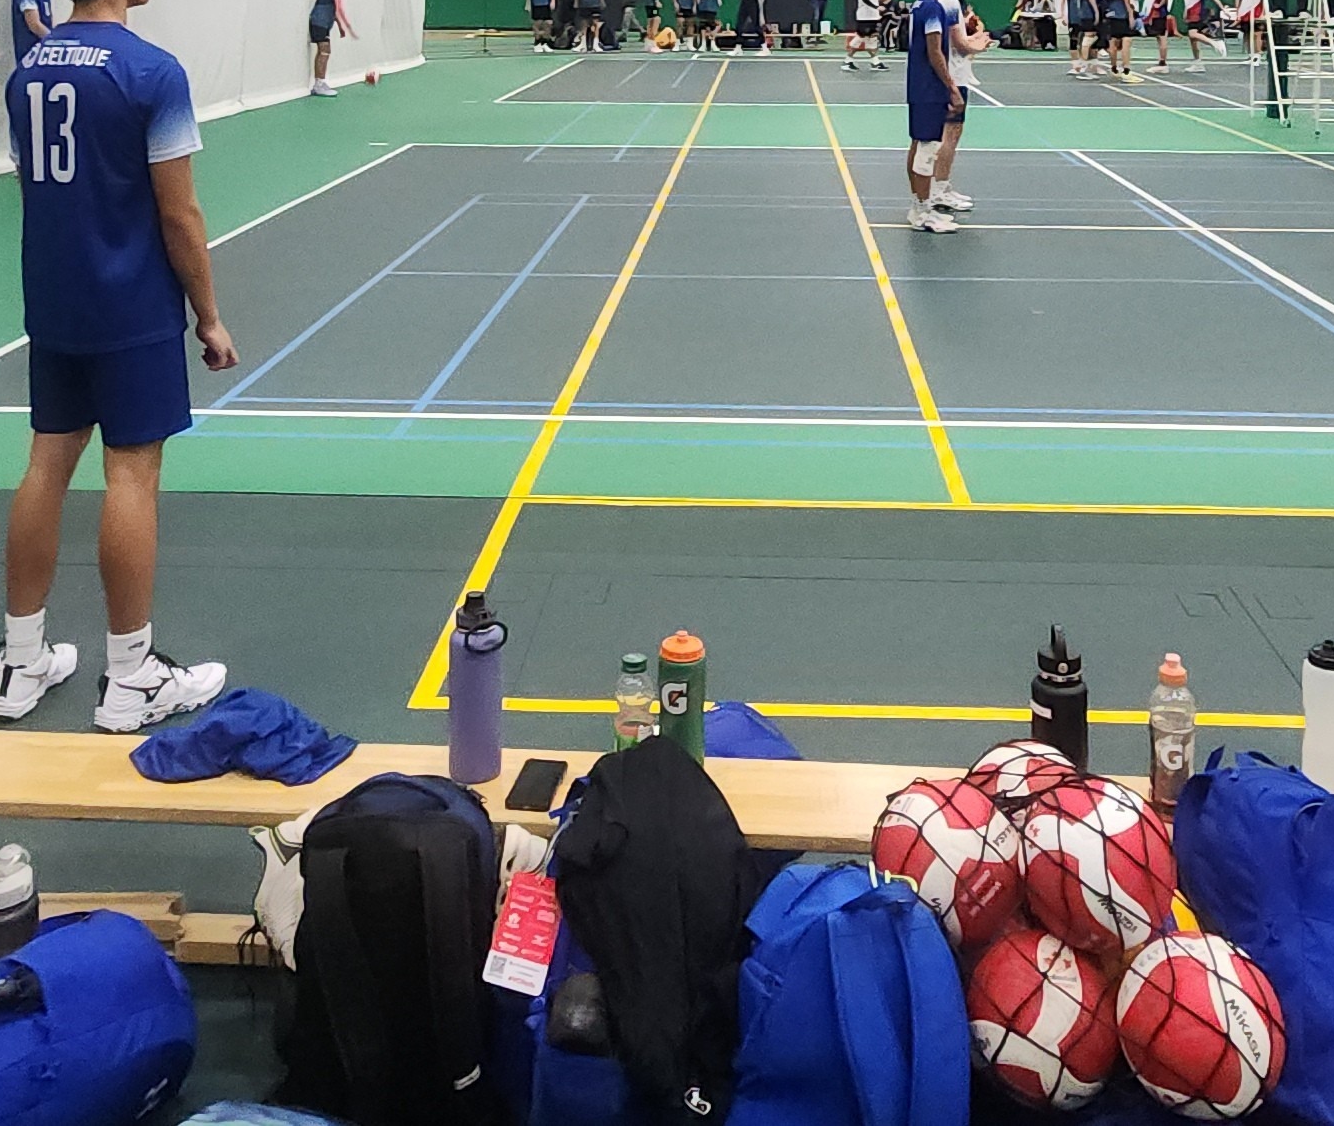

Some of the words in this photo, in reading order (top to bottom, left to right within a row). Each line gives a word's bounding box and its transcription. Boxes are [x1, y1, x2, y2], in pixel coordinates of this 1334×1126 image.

[36, 46, 112, 67] CELTIQUE
[26, 82, 76, 184] 13
[661, 681, 688, 715] G
[1160, 742, 1184, 771] G
